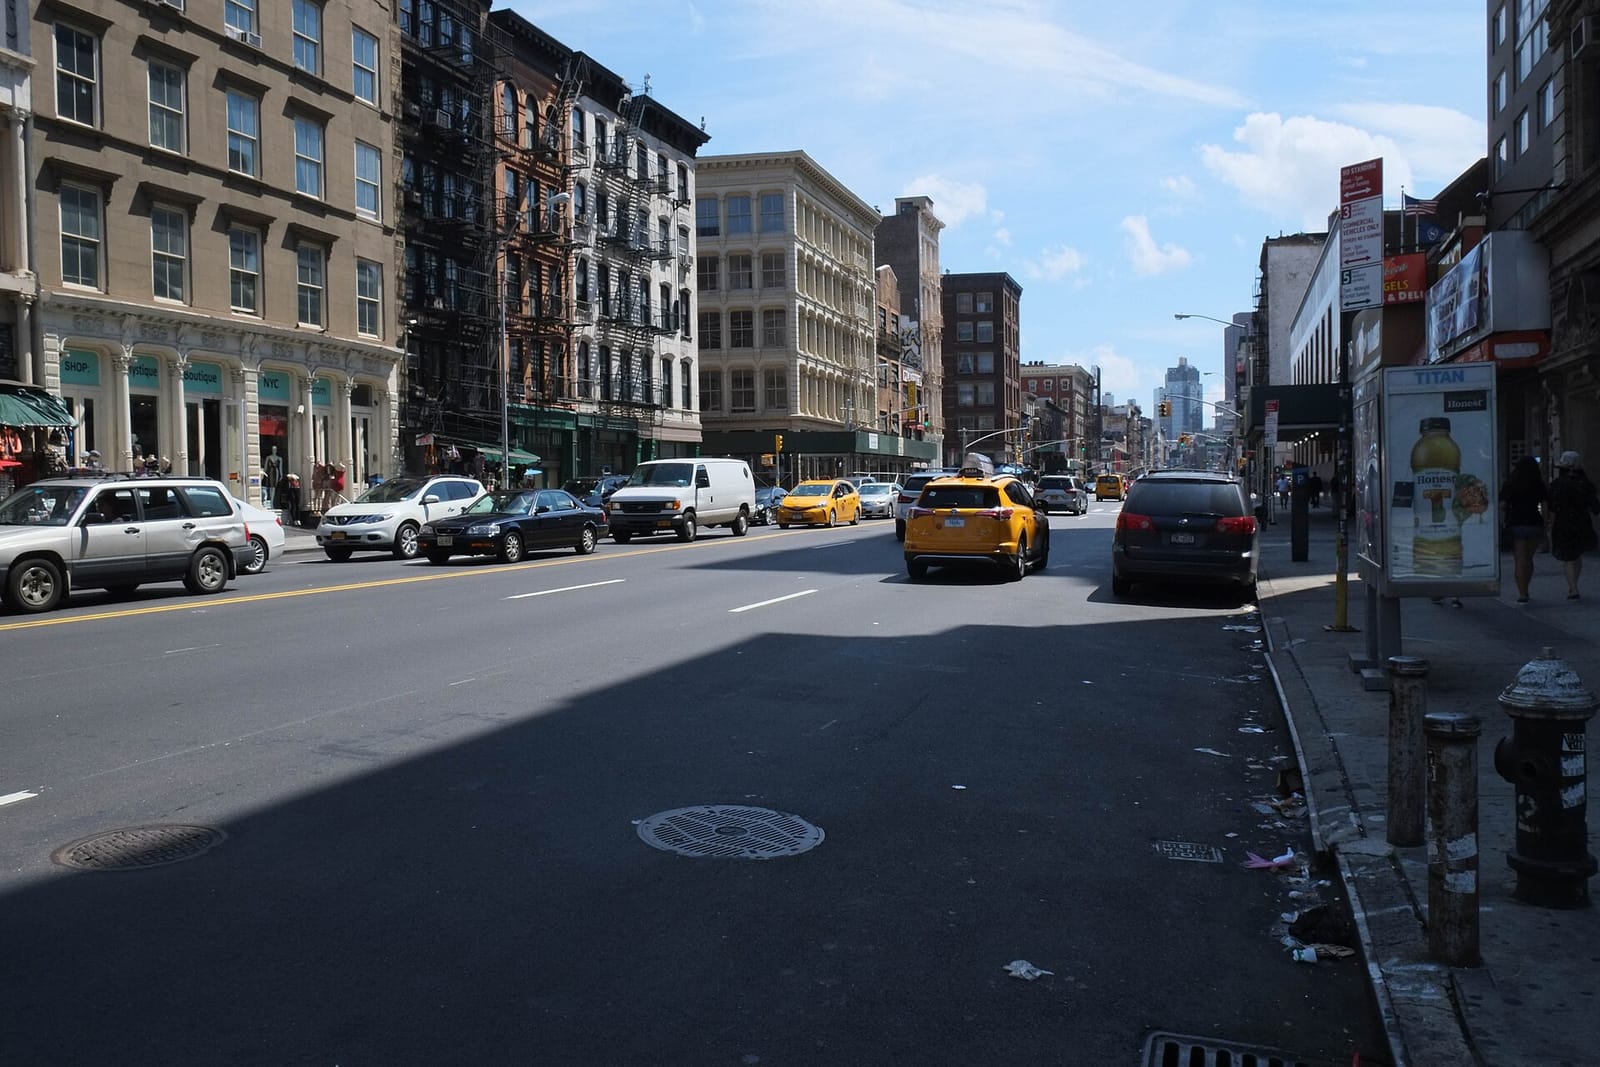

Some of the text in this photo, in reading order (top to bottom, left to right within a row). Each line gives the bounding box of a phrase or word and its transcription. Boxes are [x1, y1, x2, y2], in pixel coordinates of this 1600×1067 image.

[1342, 205, 1350, 219] 3
[1342, 217, 1374, 230] COMMERCIAL
[1342, 223, 1379, 236] VEHICLES ONLY
[1343, 270, 1350, 284] 5
[1384, 280, 1408, 291] GELS
[1398, 290, 1424, 301] DELI
[64, 360, 91, 374] SHOP:
[184, 370, 217, 385] Boutique
[263, 377, 279, 389] NYC
[1415, 370, 1465, 385] TITAN
[1297, 474, 1305, 485] P
